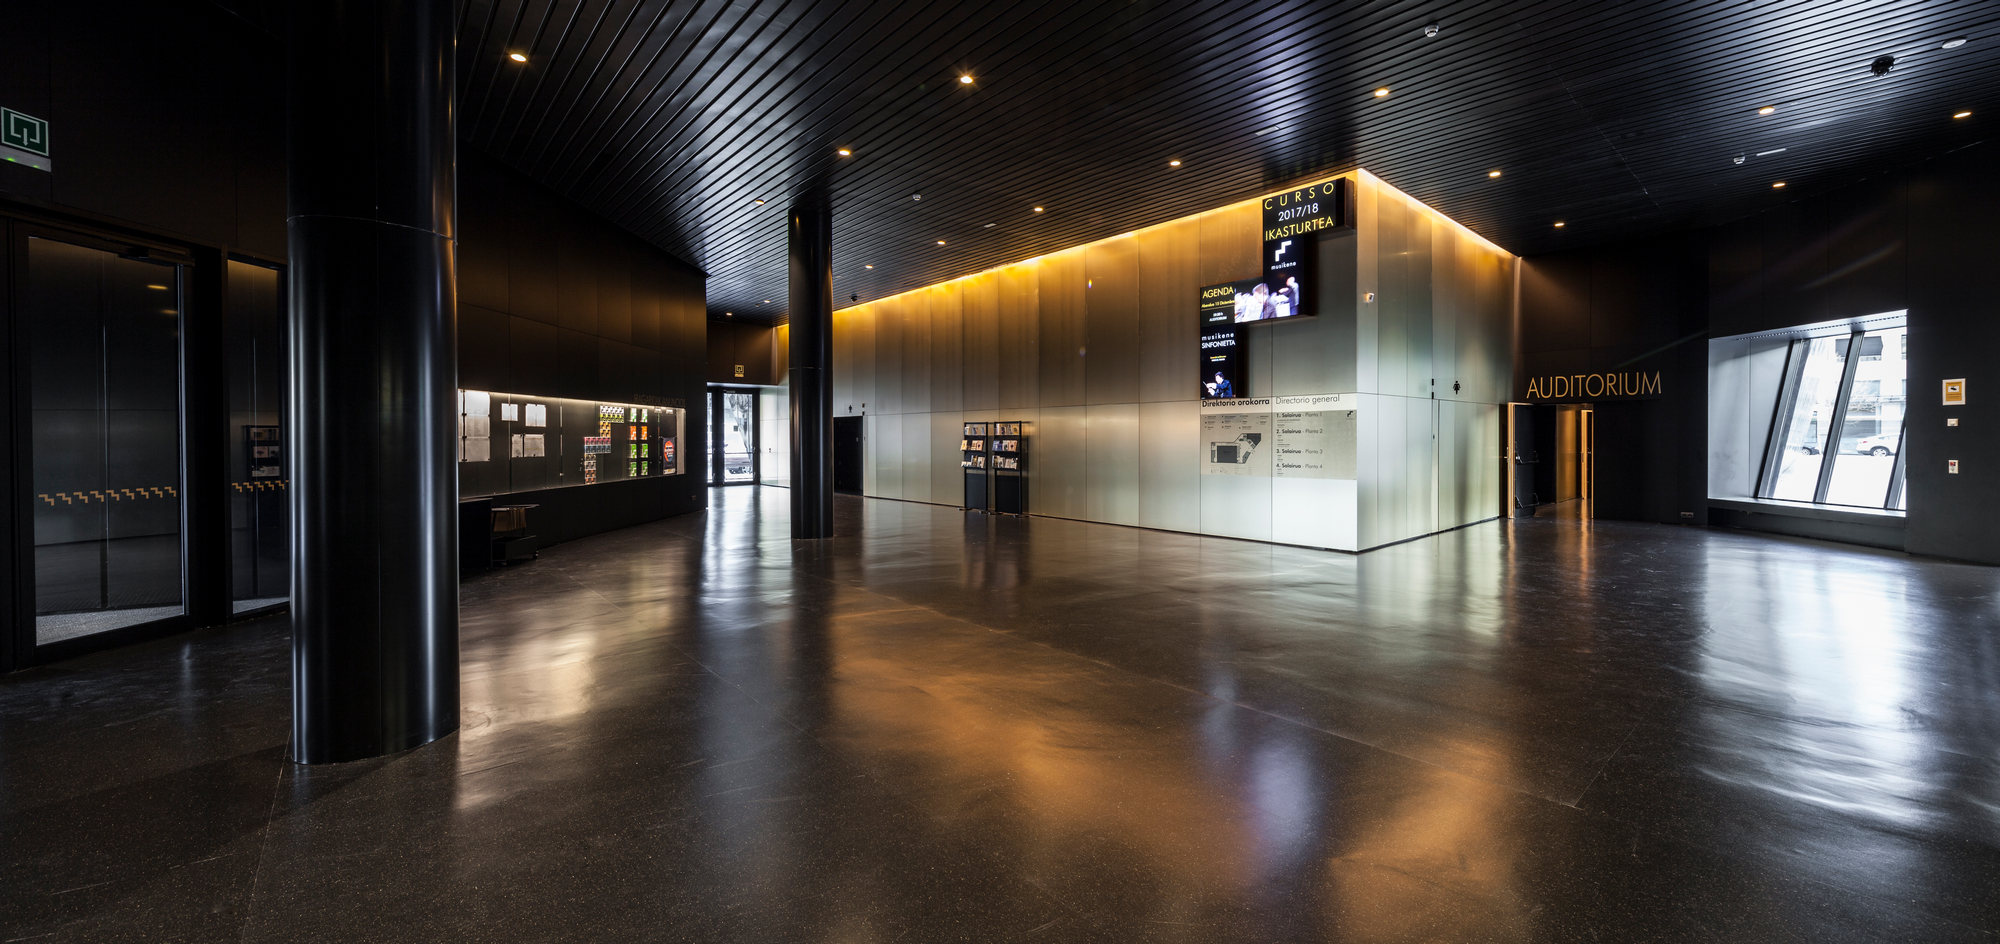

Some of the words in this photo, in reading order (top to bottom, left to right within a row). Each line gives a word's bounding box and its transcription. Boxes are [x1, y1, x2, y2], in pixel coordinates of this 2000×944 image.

[1264, 182, 1335, 210] CURSO
[1278, 203, 1319, 222] 2017/18
[1265, 216, 1334, 241] IKASTURTEA
[1202, 286, 1234, 299] AGENDA
[1201, 332, 1235, 341] musikene
[1201, 339, 1236, 349] SINFONIETTA
[1526, 370, 1662, 399] AUDITORIUM
[1202, 398, 1236, 408] Direktorio
[1237, 398, 1270, 406] orokorra
[1275, 396, 1310, 405] Directorio
[1311, 394, 1340, 405] general
